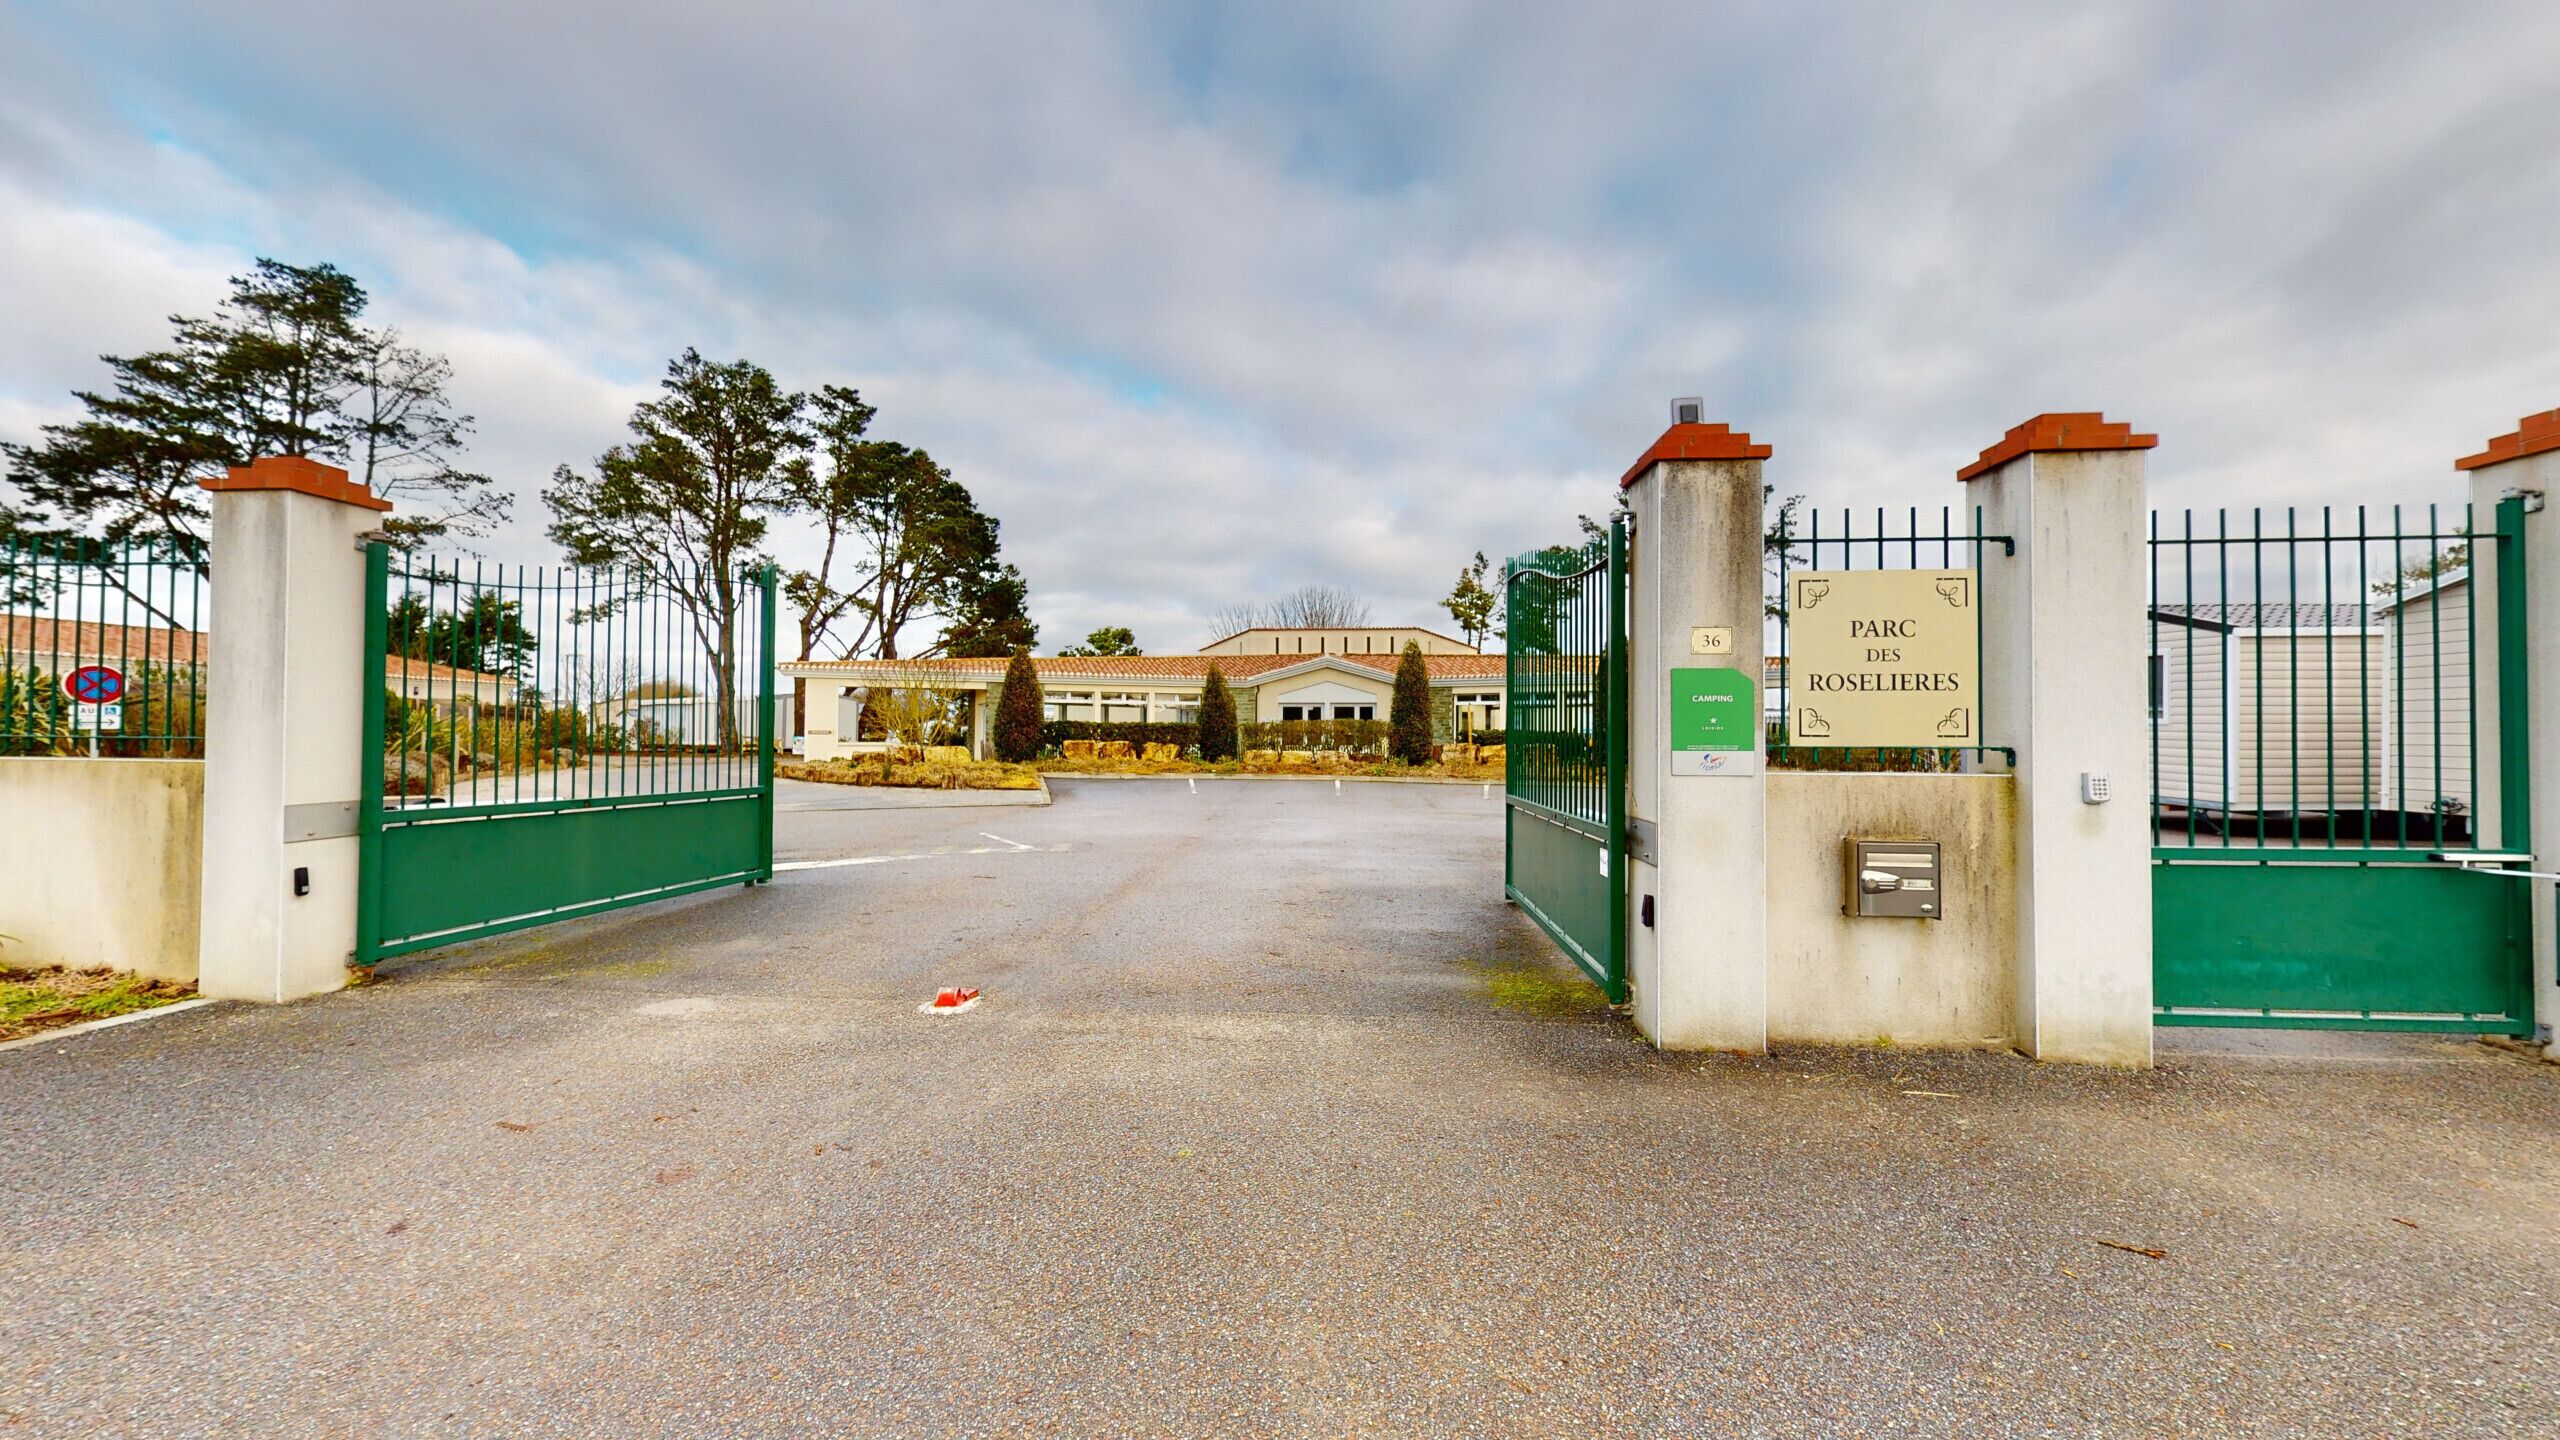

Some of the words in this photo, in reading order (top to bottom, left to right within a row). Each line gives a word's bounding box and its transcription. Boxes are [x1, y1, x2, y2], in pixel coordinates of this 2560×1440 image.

[1850, 619, 1916, 638] PARC
[1701, 633, 1721, 648] 36
[1867, 648, 1901, 663] DES
[1808, 672, 1959, 692] ROSELIERES
[1692, 695, 1734, 703] CAMPING
